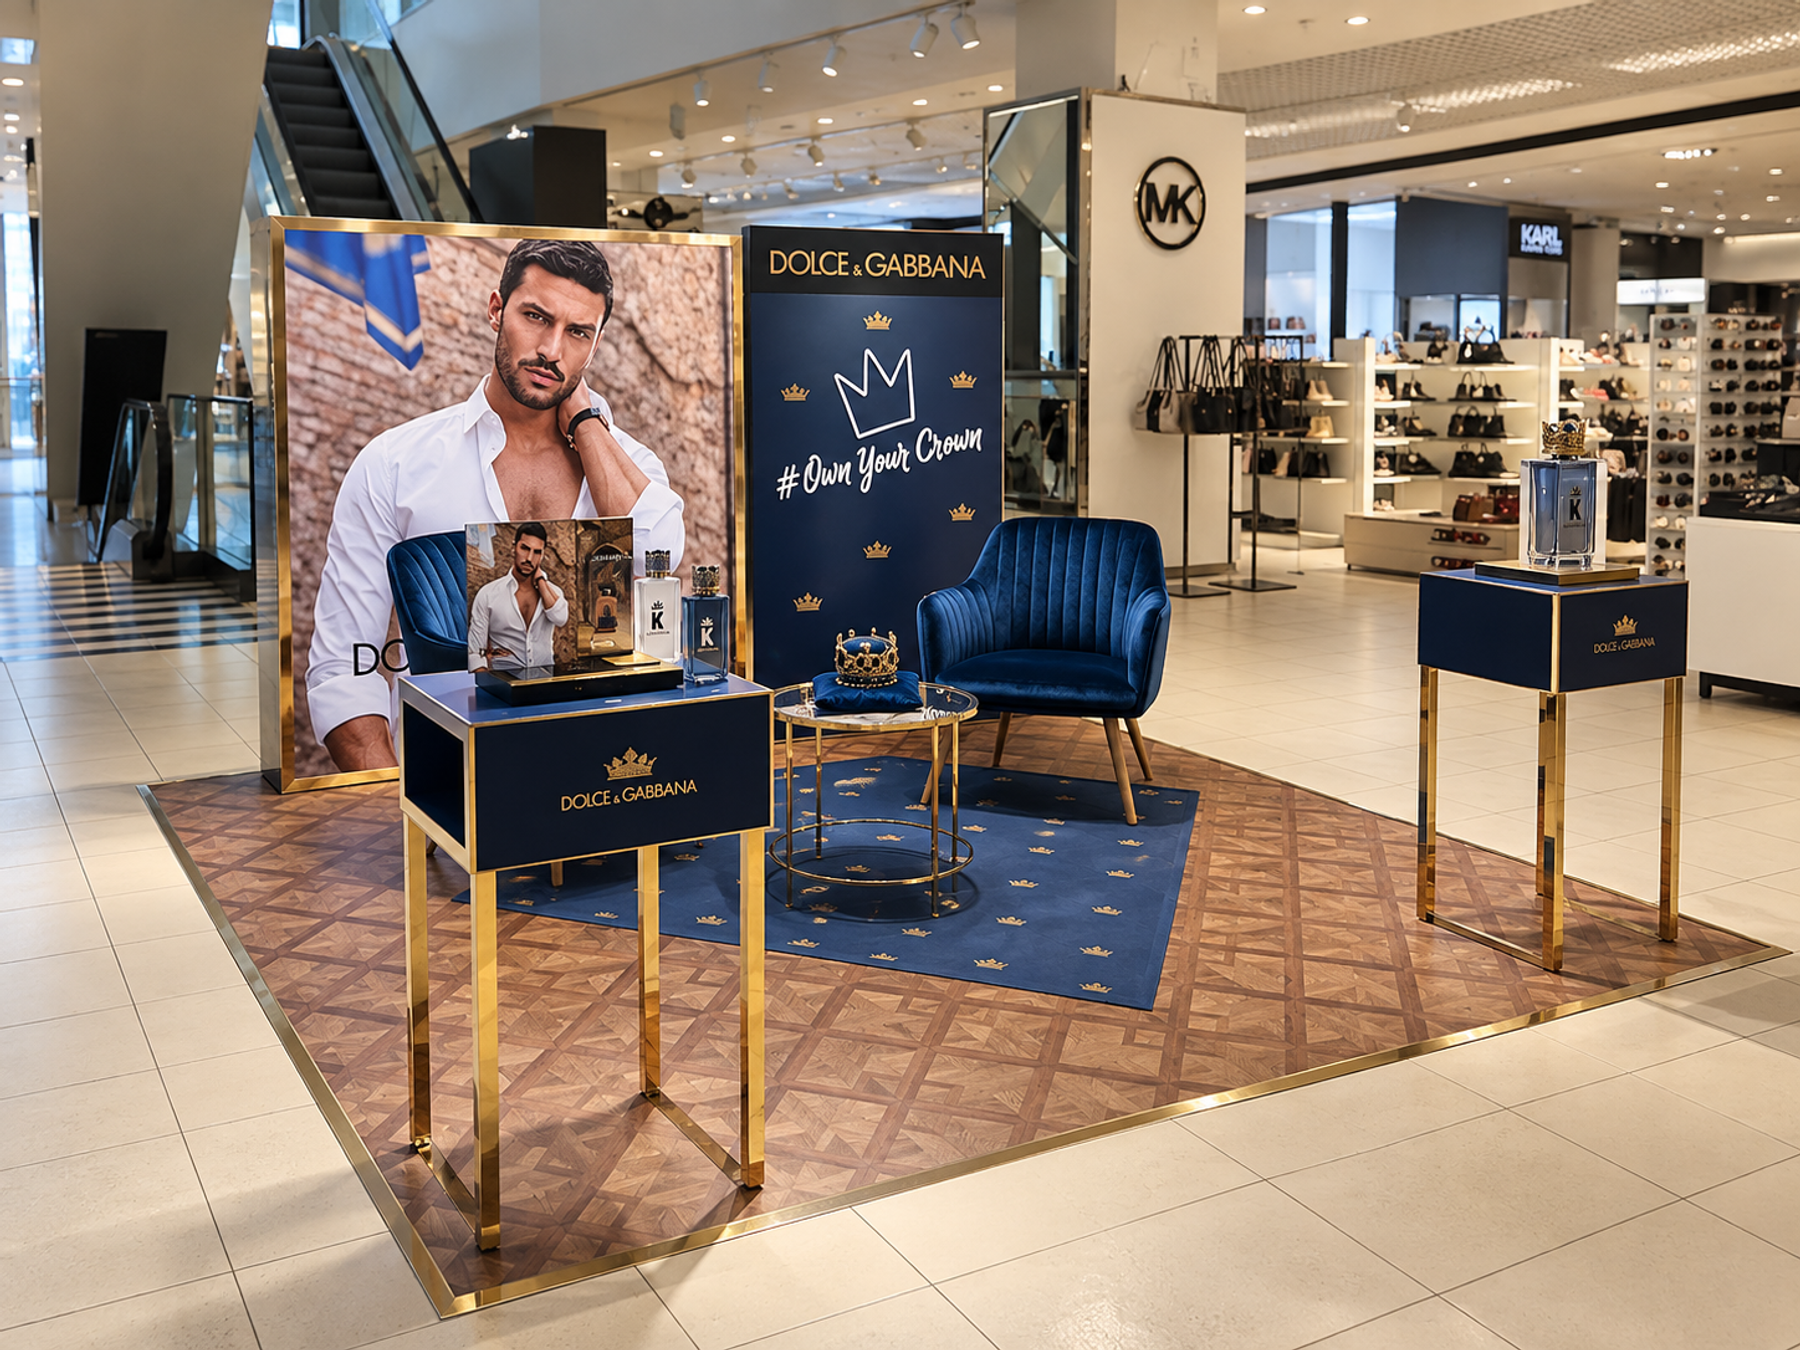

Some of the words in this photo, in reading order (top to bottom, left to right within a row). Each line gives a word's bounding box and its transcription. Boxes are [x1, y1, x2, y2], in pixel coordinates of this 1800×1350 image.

[1145, 182, 1198, 224] MK
[1521, 223, 1563, 247] KARL
[769, 249, 849, 276] DOLCE
[852, 264, 863, 277] &
[865, 252, 987, 280] GABBANA
[856, 442, 911, 494] Your
[915, 427, 983, 463] Crown
[1570, 499, 1581, 520] K
[651, 611, 664, 630] K
[701, 627, 714, 647] K
[561, 790, 611, 811] DOLCE
[613, 794, 620, 804] &
[621, 779, 698, 802] GABBANA
